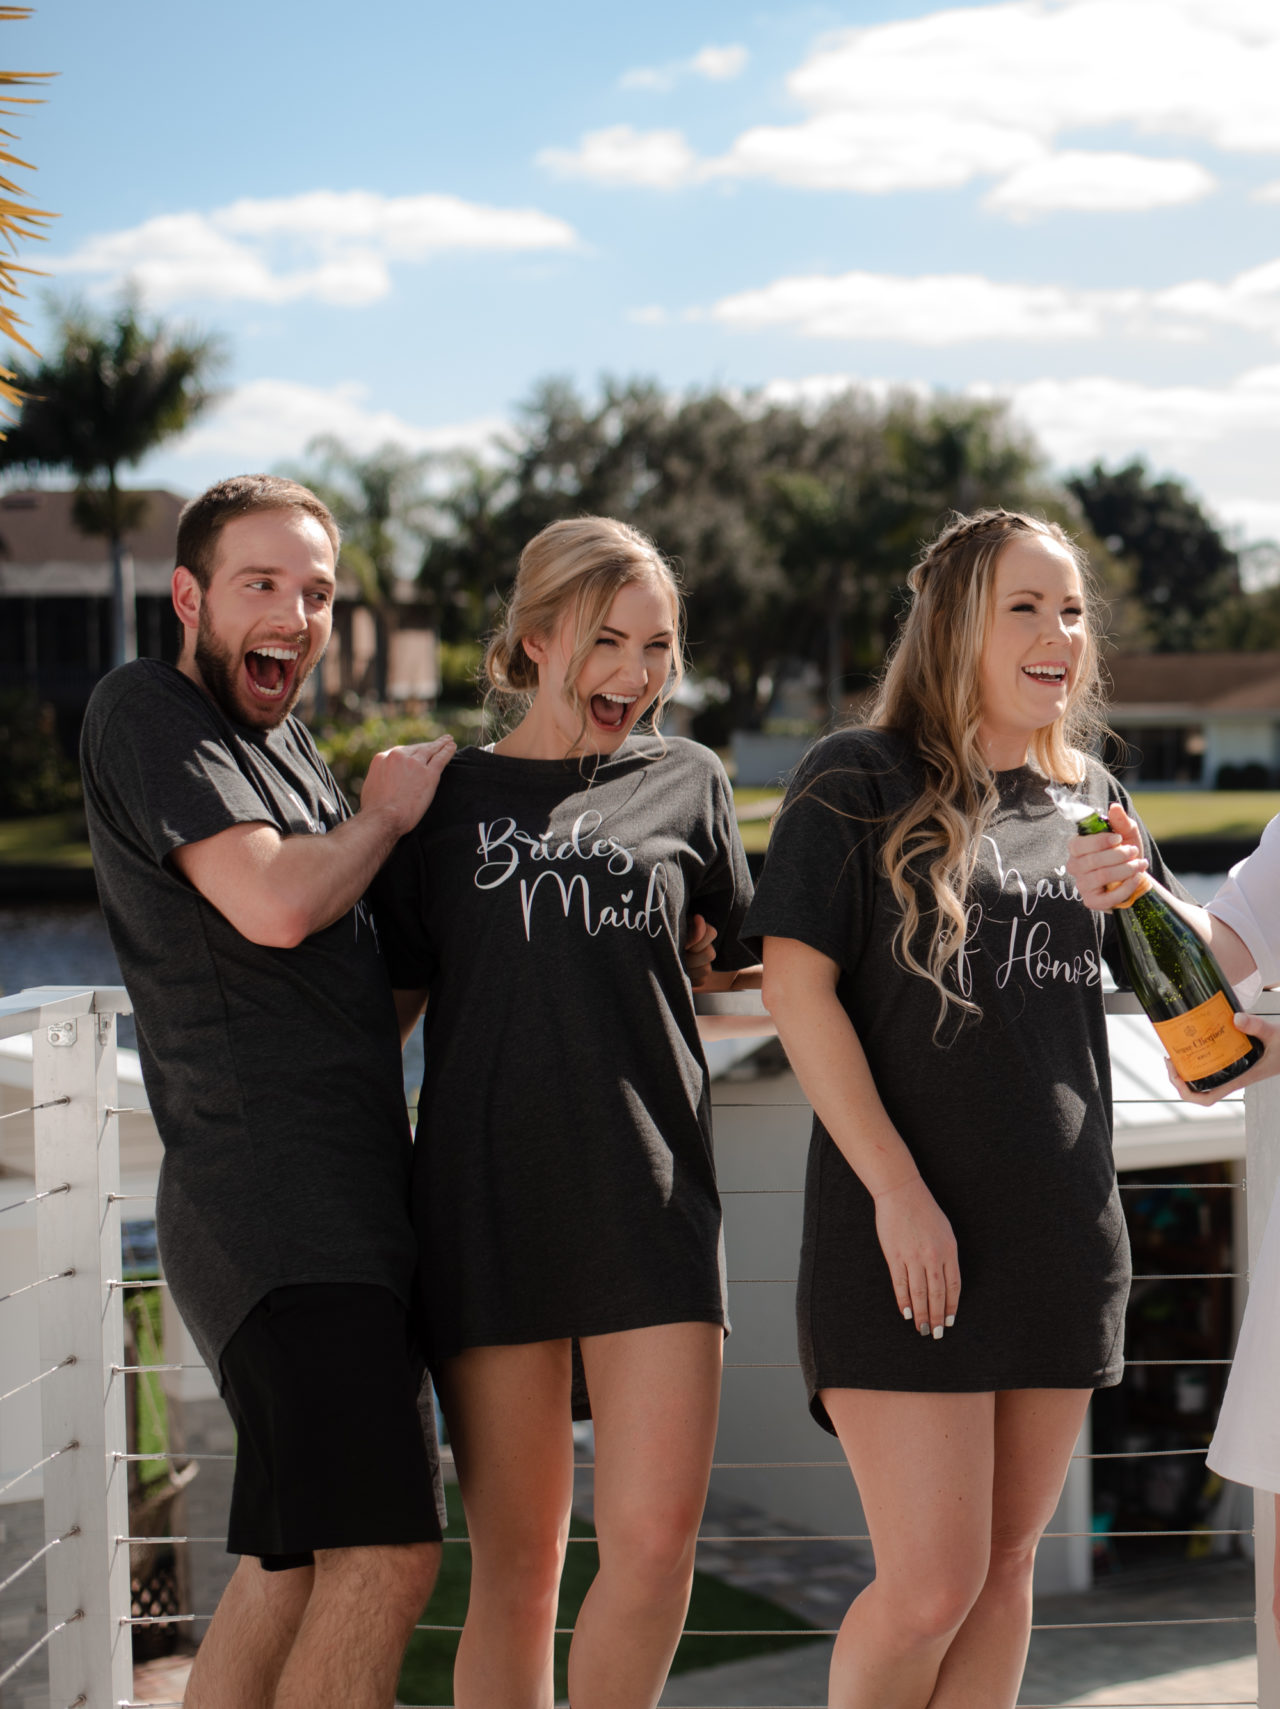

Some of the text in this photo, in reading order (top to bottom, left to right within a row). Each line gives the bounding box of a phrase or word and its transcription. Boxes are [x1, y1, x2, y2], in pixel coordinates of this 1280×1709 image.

[474, 809, 637, 890] Brides
[965, 834, 1084, 916] Mai
[520, 862, 668, 942] Maid
[996, 916, 1101, 989] Honor
